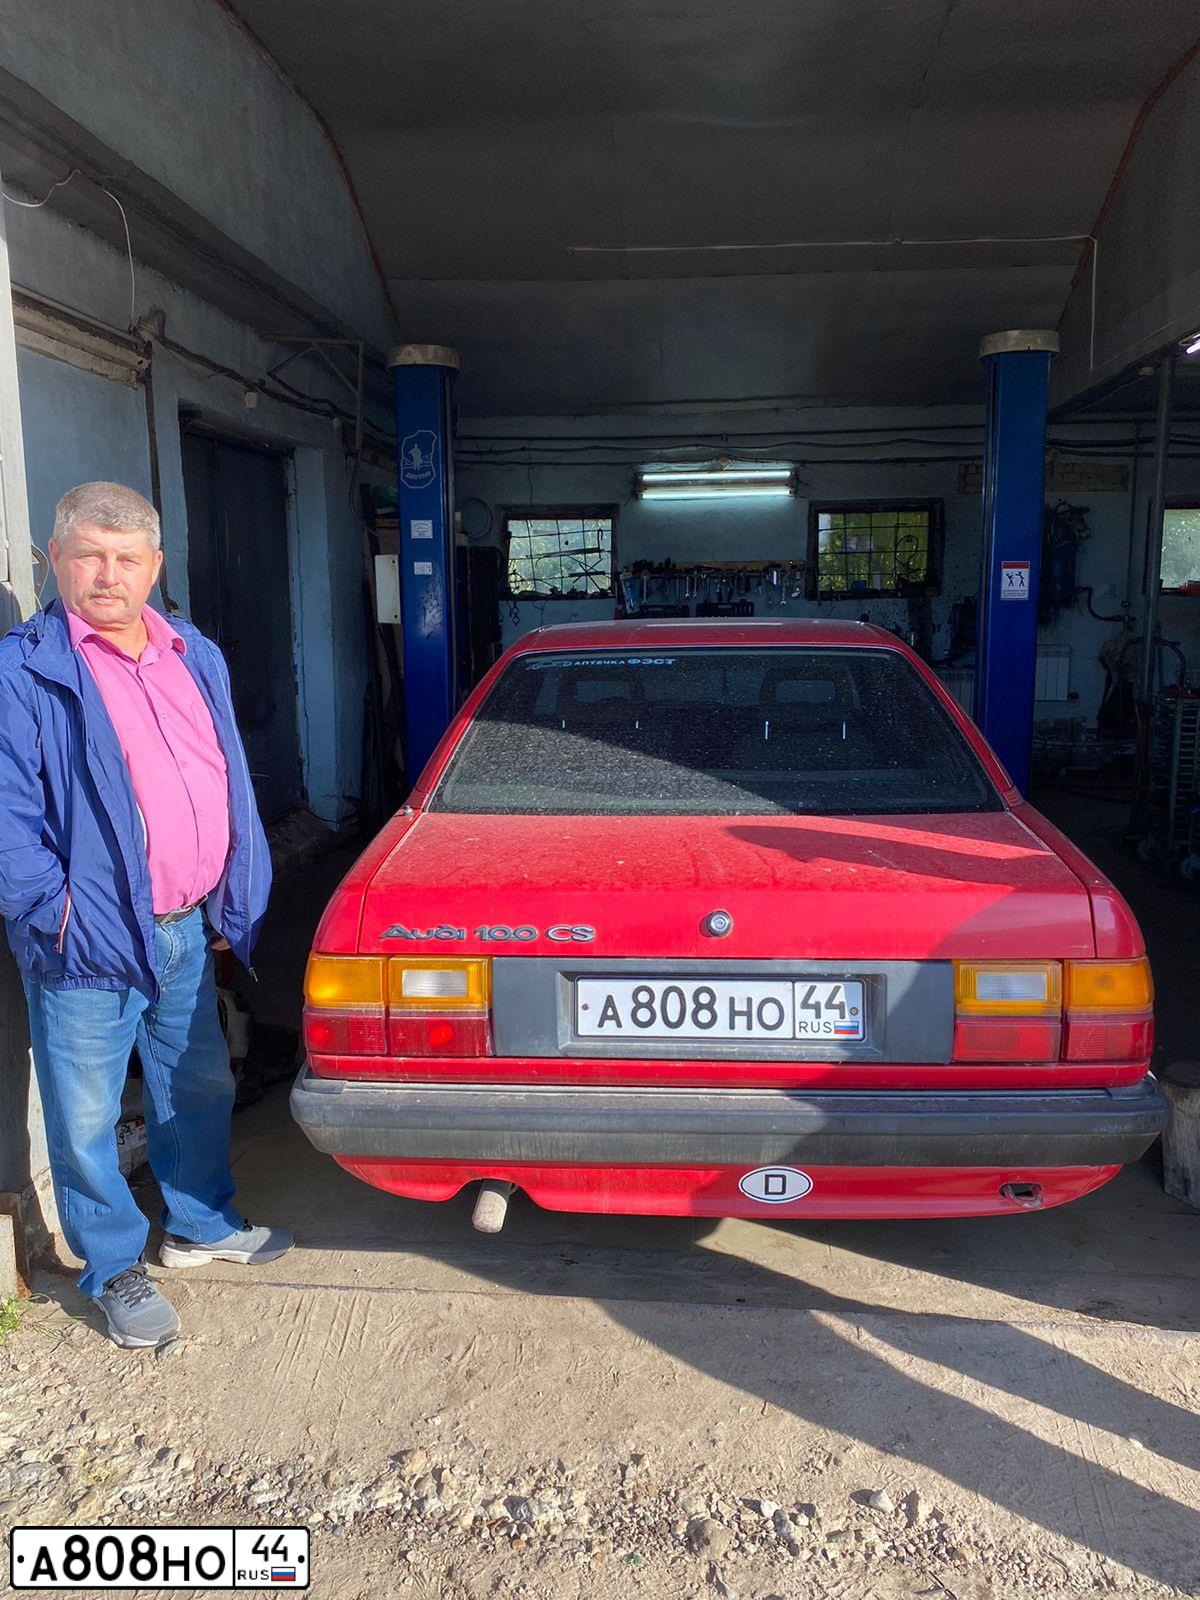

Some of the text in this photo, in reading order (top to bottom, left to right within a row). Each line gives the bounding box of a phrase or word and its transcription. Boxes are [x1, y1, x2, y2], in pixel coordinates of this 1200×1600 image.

[627, 658, 676, 666] ФЭСТ
[378, 924, 595, 942] Audi 100 CS
[597, 984, 847, 1031] А808НО 44
[799, 1021, 832, 1034] RUS
[764, 1174, 787, 1195] D
